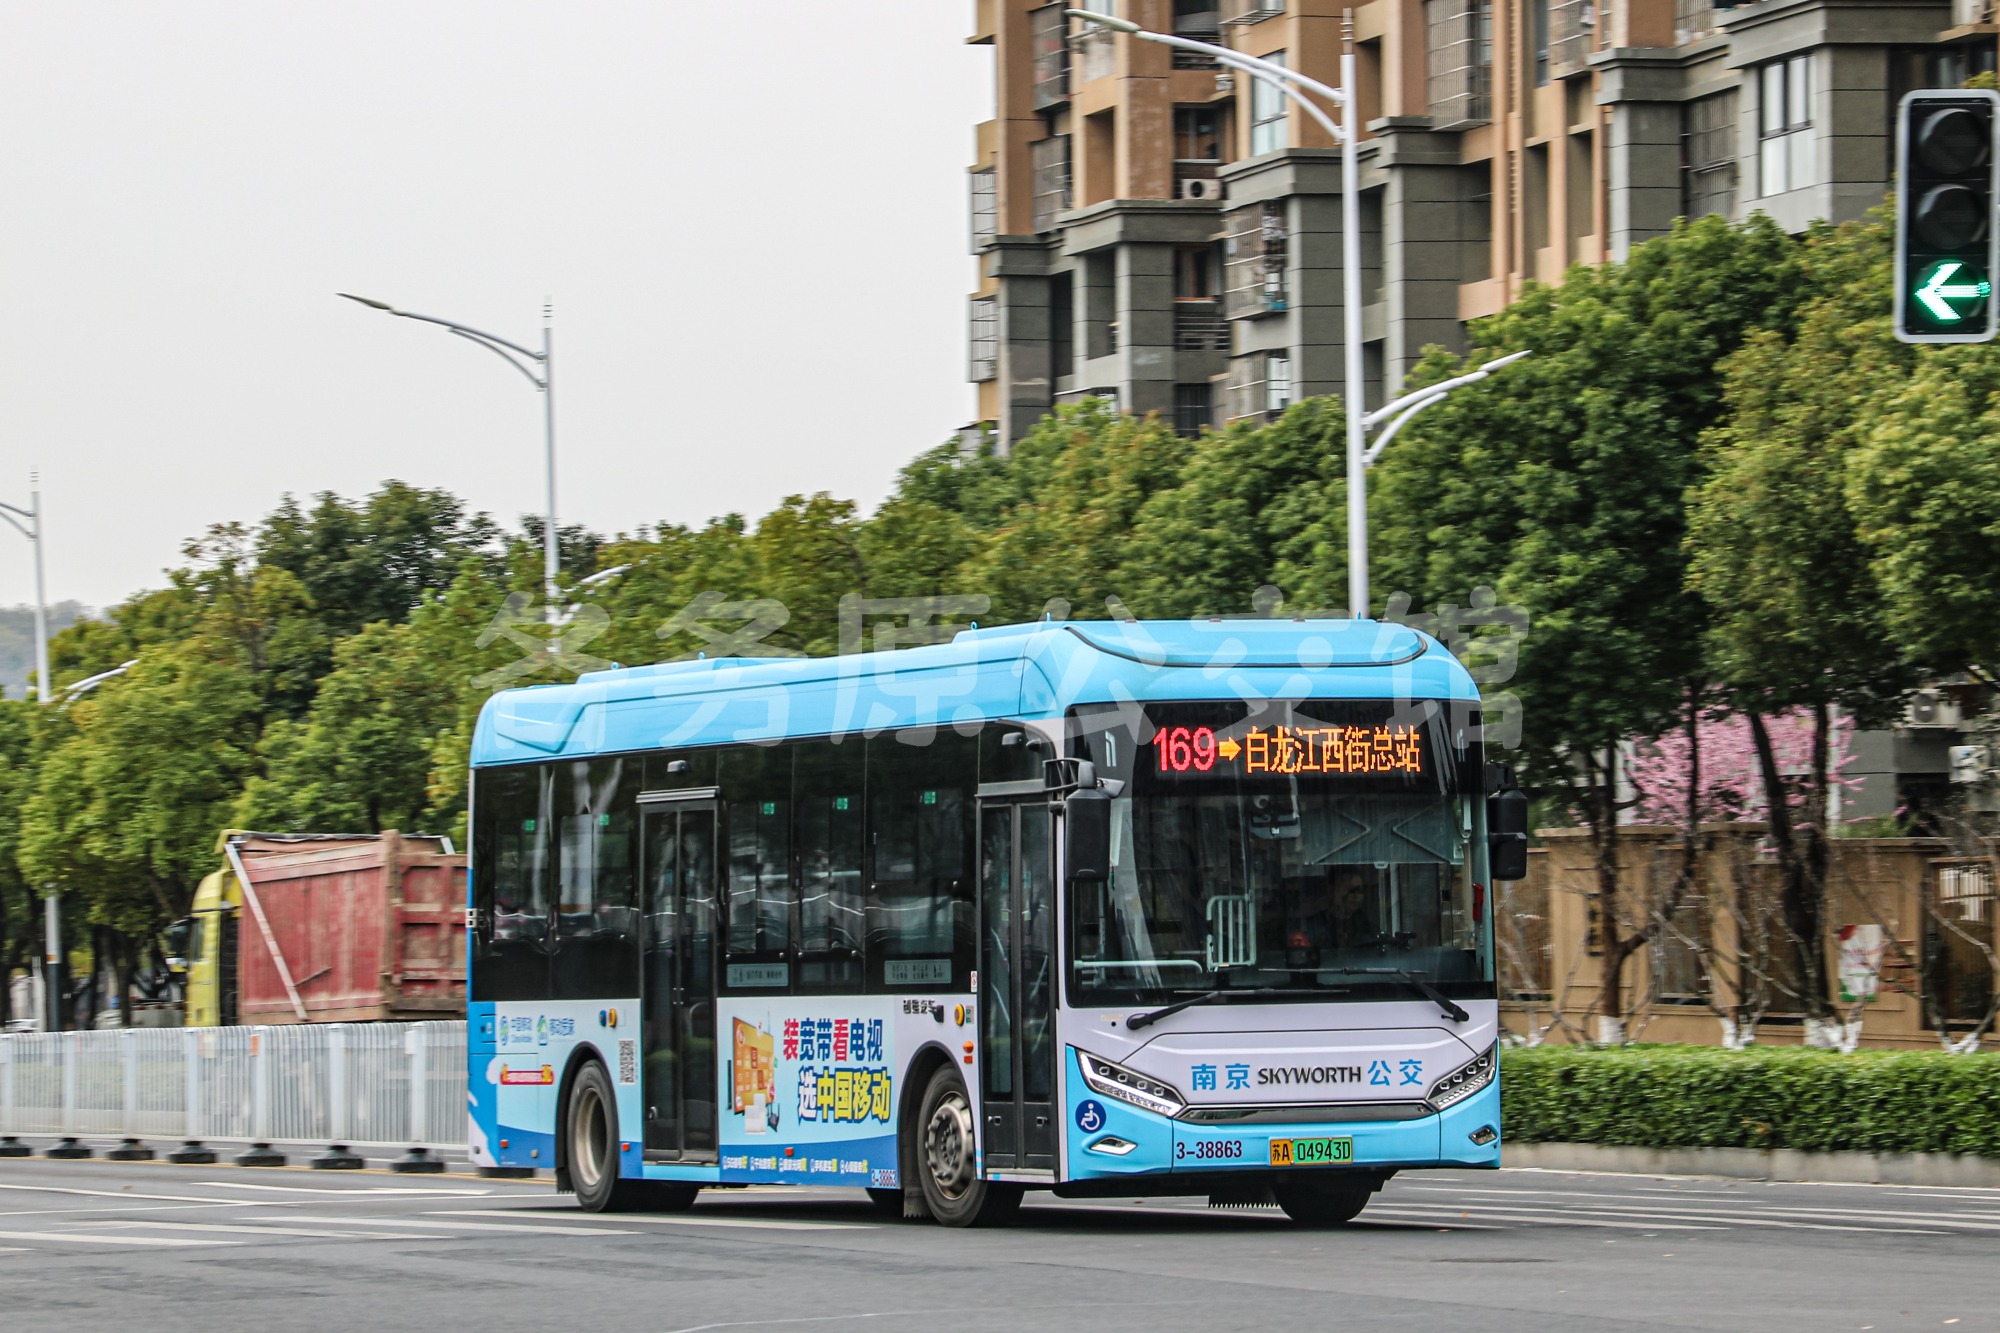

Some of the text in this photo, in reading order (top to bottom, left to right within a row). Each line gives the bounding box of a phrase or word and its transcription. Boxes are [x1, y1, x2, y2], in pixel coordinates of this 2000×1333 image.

[1153, 724, 1422, 774] 169 白龙江西街总站
[783, 1017, 883, 1063] 装宽带看电视
[797, 1065, 892, 1124] 选中国移动
[1191, 1059, 1424, 1092] 南京 SKYWORTH 公交
[1176, 1139, 1242, 1160] 3-38863
